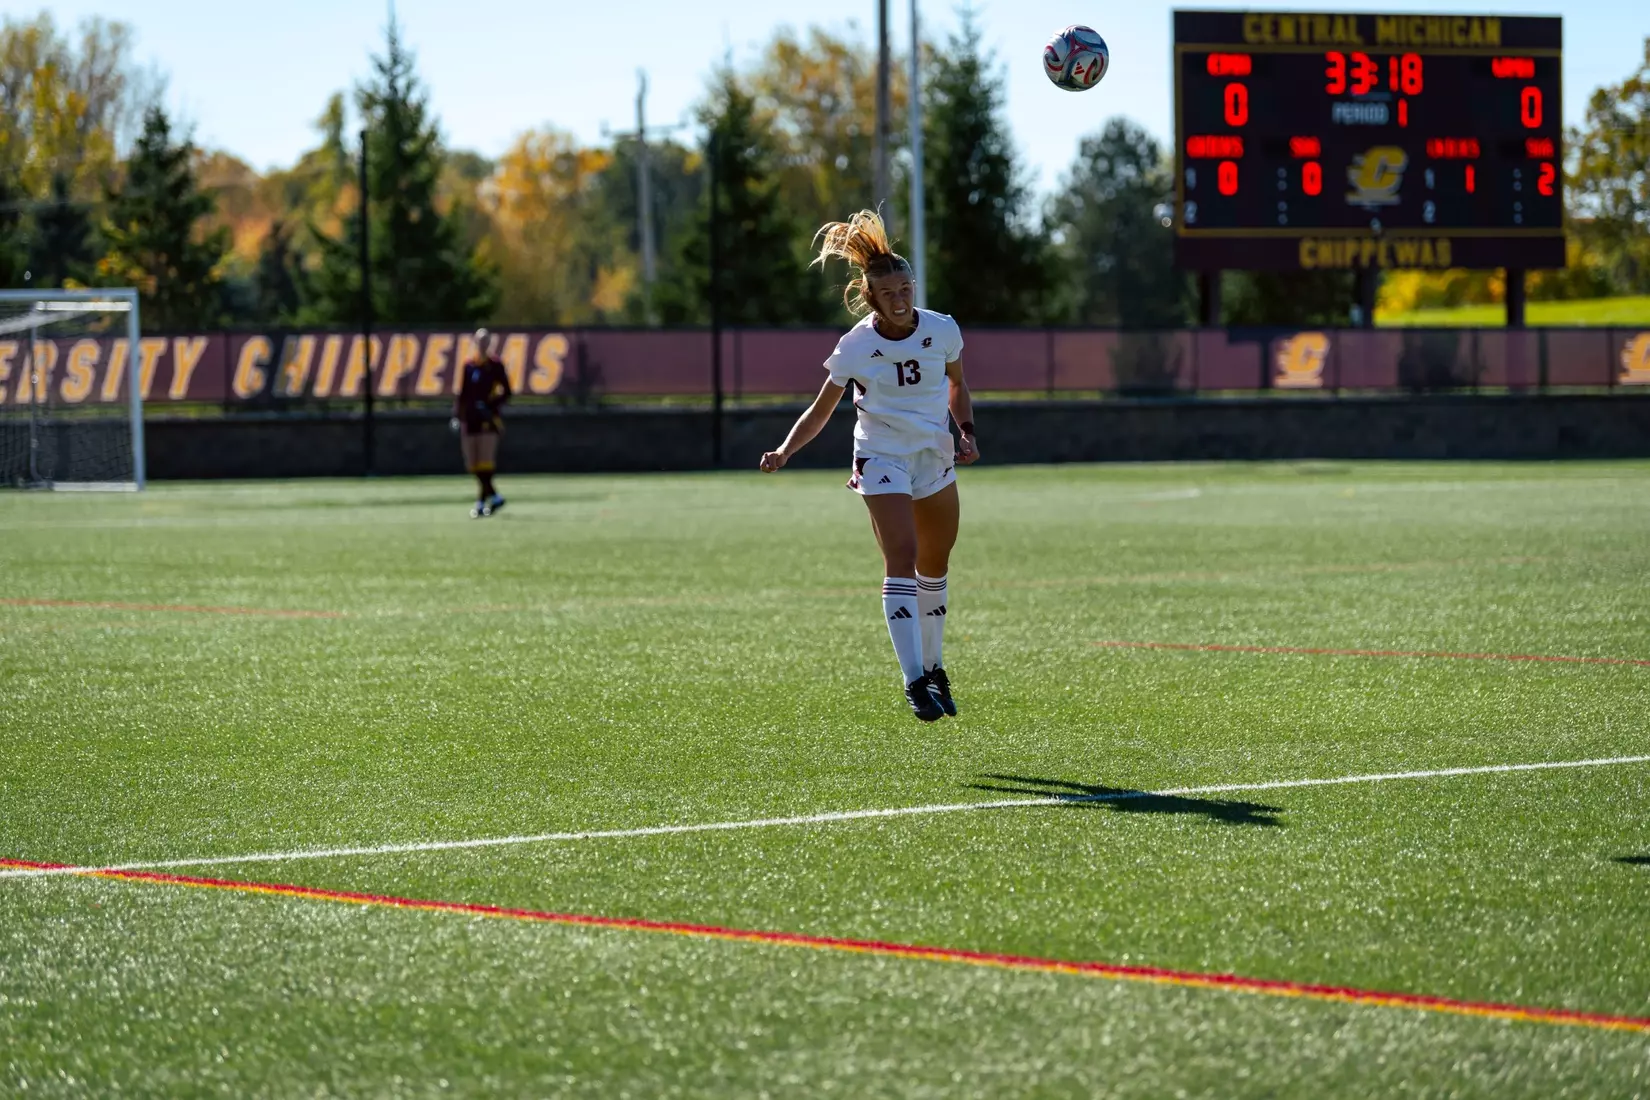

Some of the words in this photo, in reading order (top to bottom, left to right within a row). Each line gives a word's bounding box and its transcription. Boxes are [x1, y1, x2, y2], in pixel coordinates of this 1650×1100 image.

[1243, 14, 1363, 44] CENTRAL
[1376, 16, 1501, 46] MICHIGAN
[1325, 51, 1423, 95] 33:18
[1224, 82, 1248, 126] 0
[1332, 101, 1389, 125] PERIOD
[1398, 98, 1408, 127] 1
[1521, 86, 1542, 128] 0
[1218, 161, 1238, 195] 0
[1302, 161, 1322, 196] 0
[1465, 164, 1475, 194] 1
[1537, 162, 1555, 196] 2
[1300, 237, 1452, 269] CHIPPEWAS
[893, 359, 921, 387] 13
